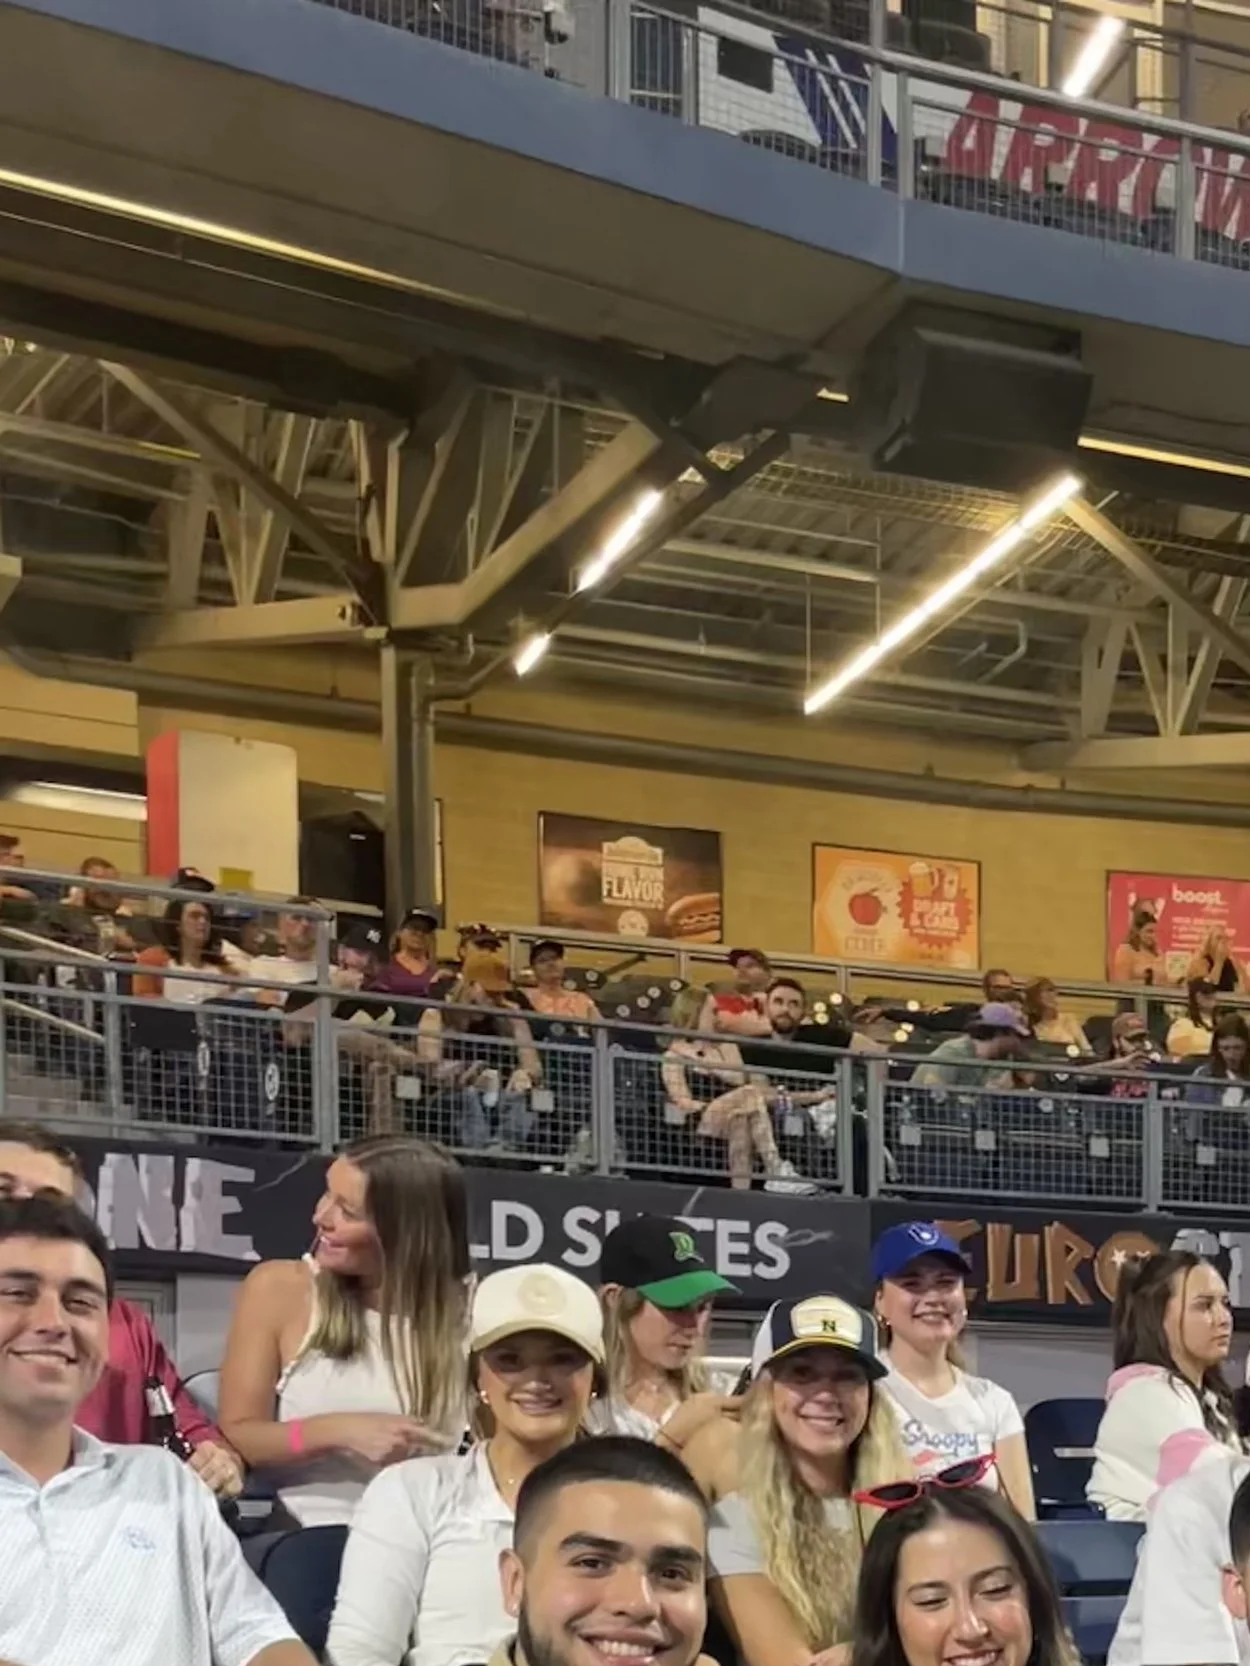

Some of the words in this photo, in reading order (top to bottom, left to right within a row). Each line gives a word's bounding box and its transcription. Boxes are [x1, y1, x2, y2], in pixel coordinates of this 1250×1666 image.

[82, 1152, 262, 1262] NE
[561, 1205, 791, 1280] SES
[902, 1418, 979, 1458] Snoopy
